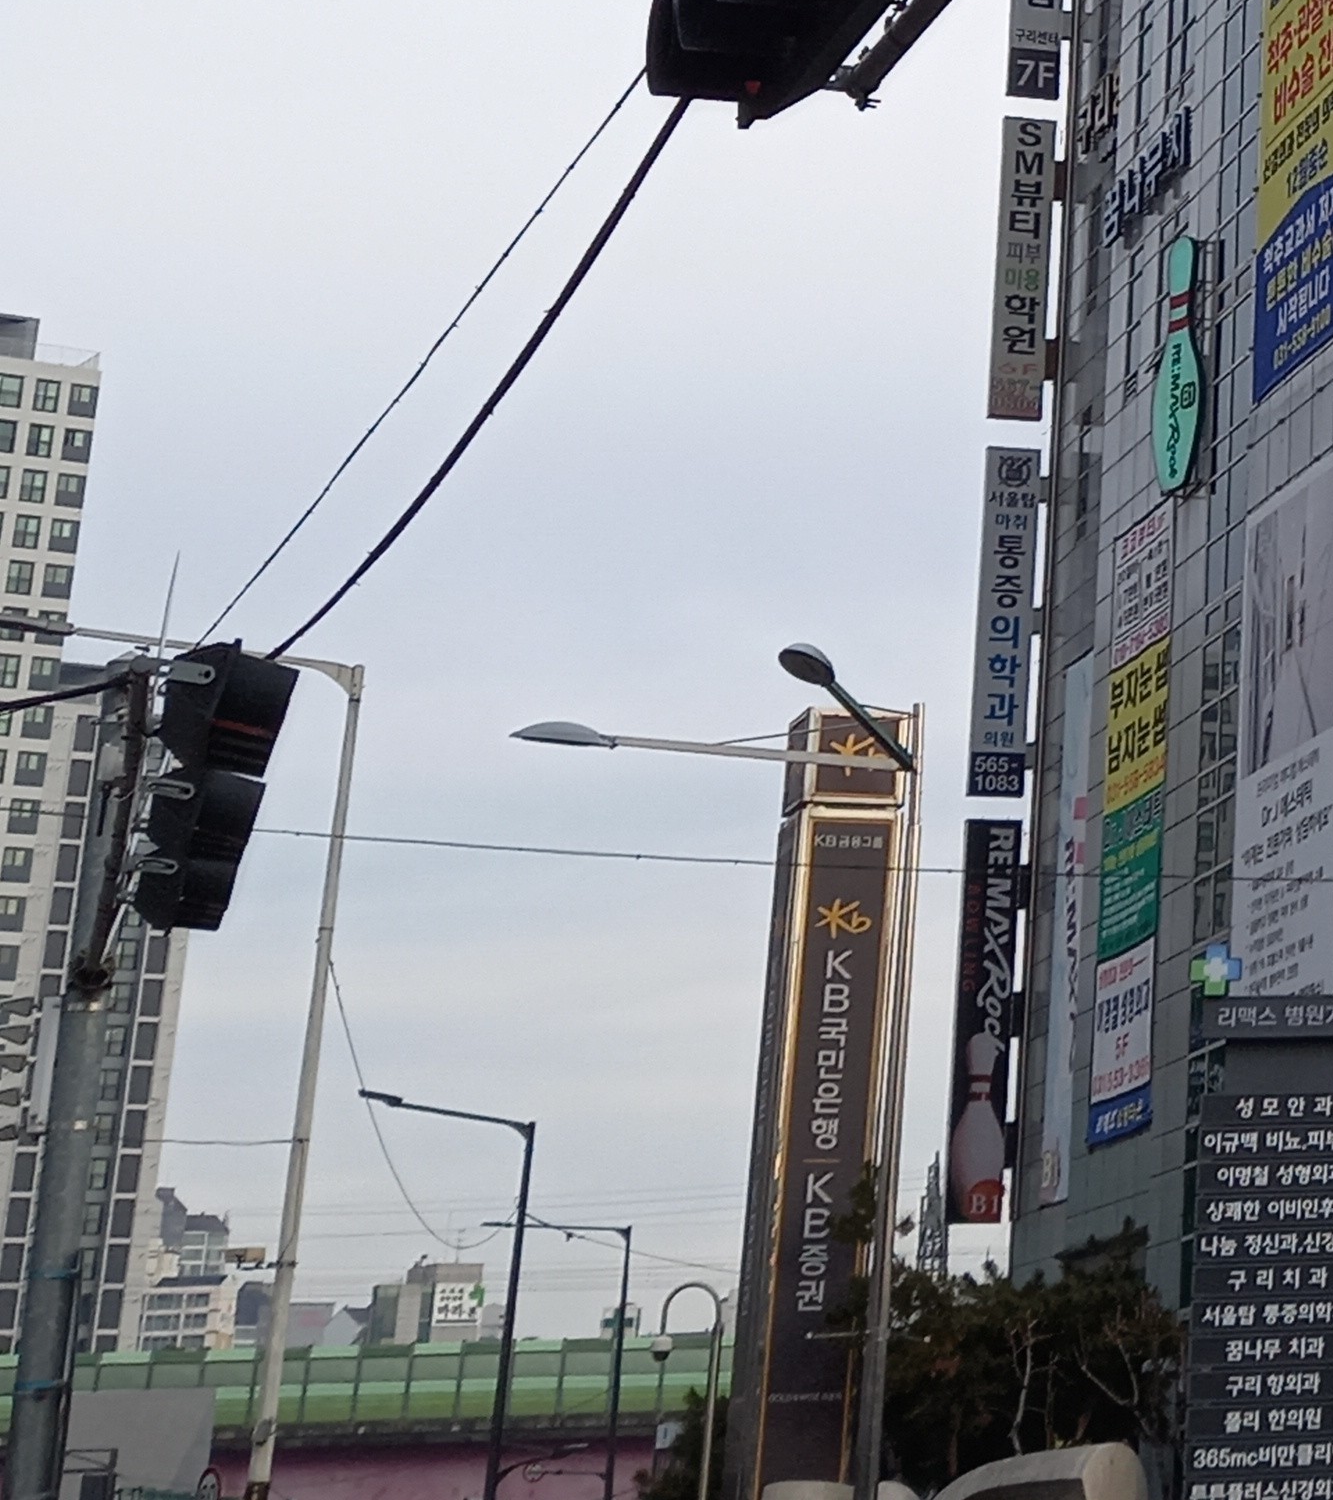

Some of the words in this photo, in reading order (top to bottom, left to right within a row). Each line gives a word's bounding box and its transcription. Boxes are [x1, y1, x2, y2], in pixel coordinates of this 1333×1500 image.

[1016, 59, 1055, 89] 7F
[972, 773, 1021, 792] 1083
[1218, 1006, 1277, 1027] 리맥스
[1235, 1096, 1333, 1118] 성모안과
[1204, 1131, 1259, 1153] 이규백
[1217, 1166, 1269, 1187] 이명철
[969, 1195, 999, 1214] B1
[1288, 1337, 1325, 1358] 치과
[1226, 1376, 1261, 1397] 구리
